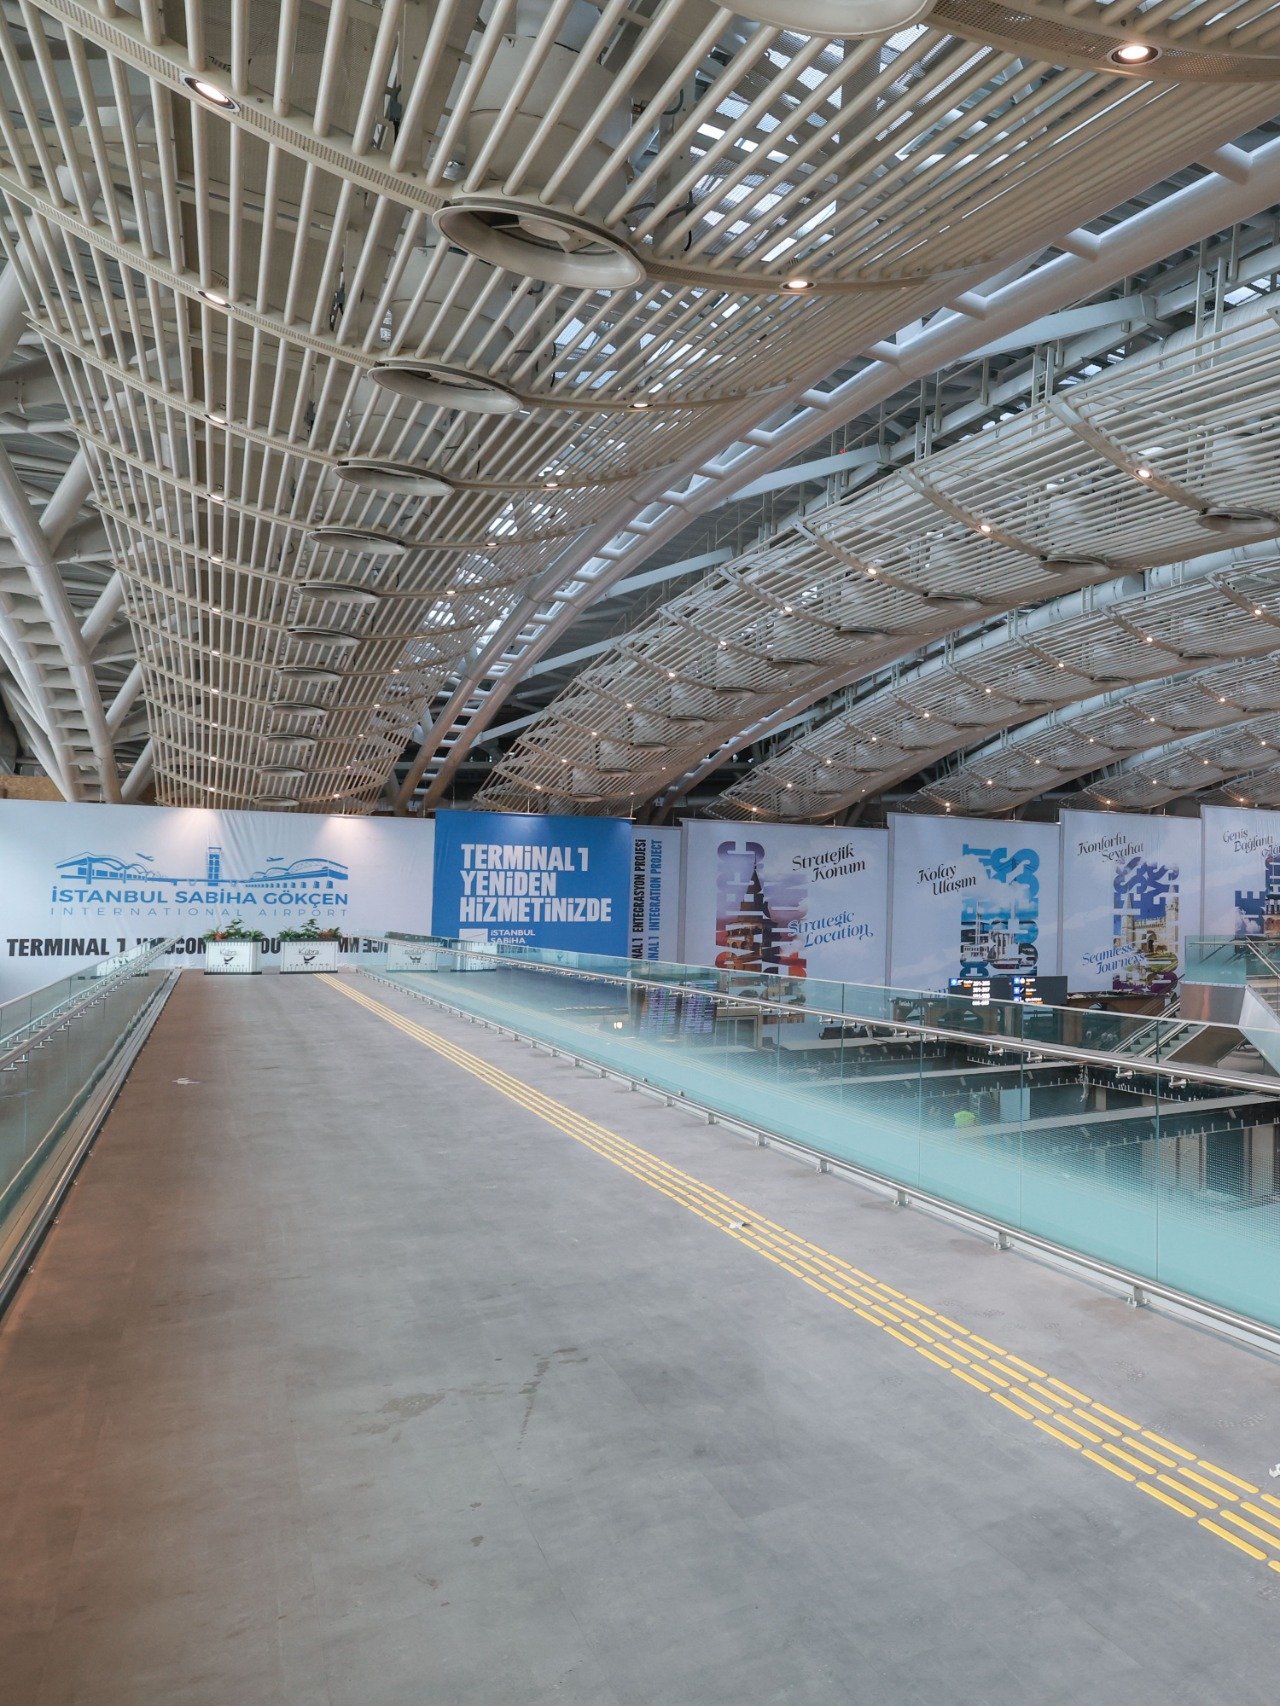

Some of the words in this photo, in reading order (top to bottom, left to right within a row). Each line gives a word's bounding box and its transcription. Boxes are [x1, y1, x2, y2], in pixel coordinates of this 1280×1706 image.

[578, 847, 589, 872] 1
[650, 840, 662, 874] PROJECT
[792, 842, 855, 871] Stratejik
[811, 860, 866, 882] Konum
[917, 864, 957, 884] Kolay
[51, 886, 168, 904] İSTANBUL
[174, 888, 257, 905] SABİHA
[263, 889, 348, 909] GÖKÇEN
[932, 875, 977, 896] Ulaşım
[51, 907, 243, 917] INTERNATIONAL
[258, 908, 348, 917] AIRPORT
[632, 874, 645, 932] ENTEGRASYON
[649, 877, 661, 930] INTEGRATION
[788, 911, 855, 936] Strategic
[804, 922, 874, 948] Location
[7, 938, 110, 957] TERMINAL
